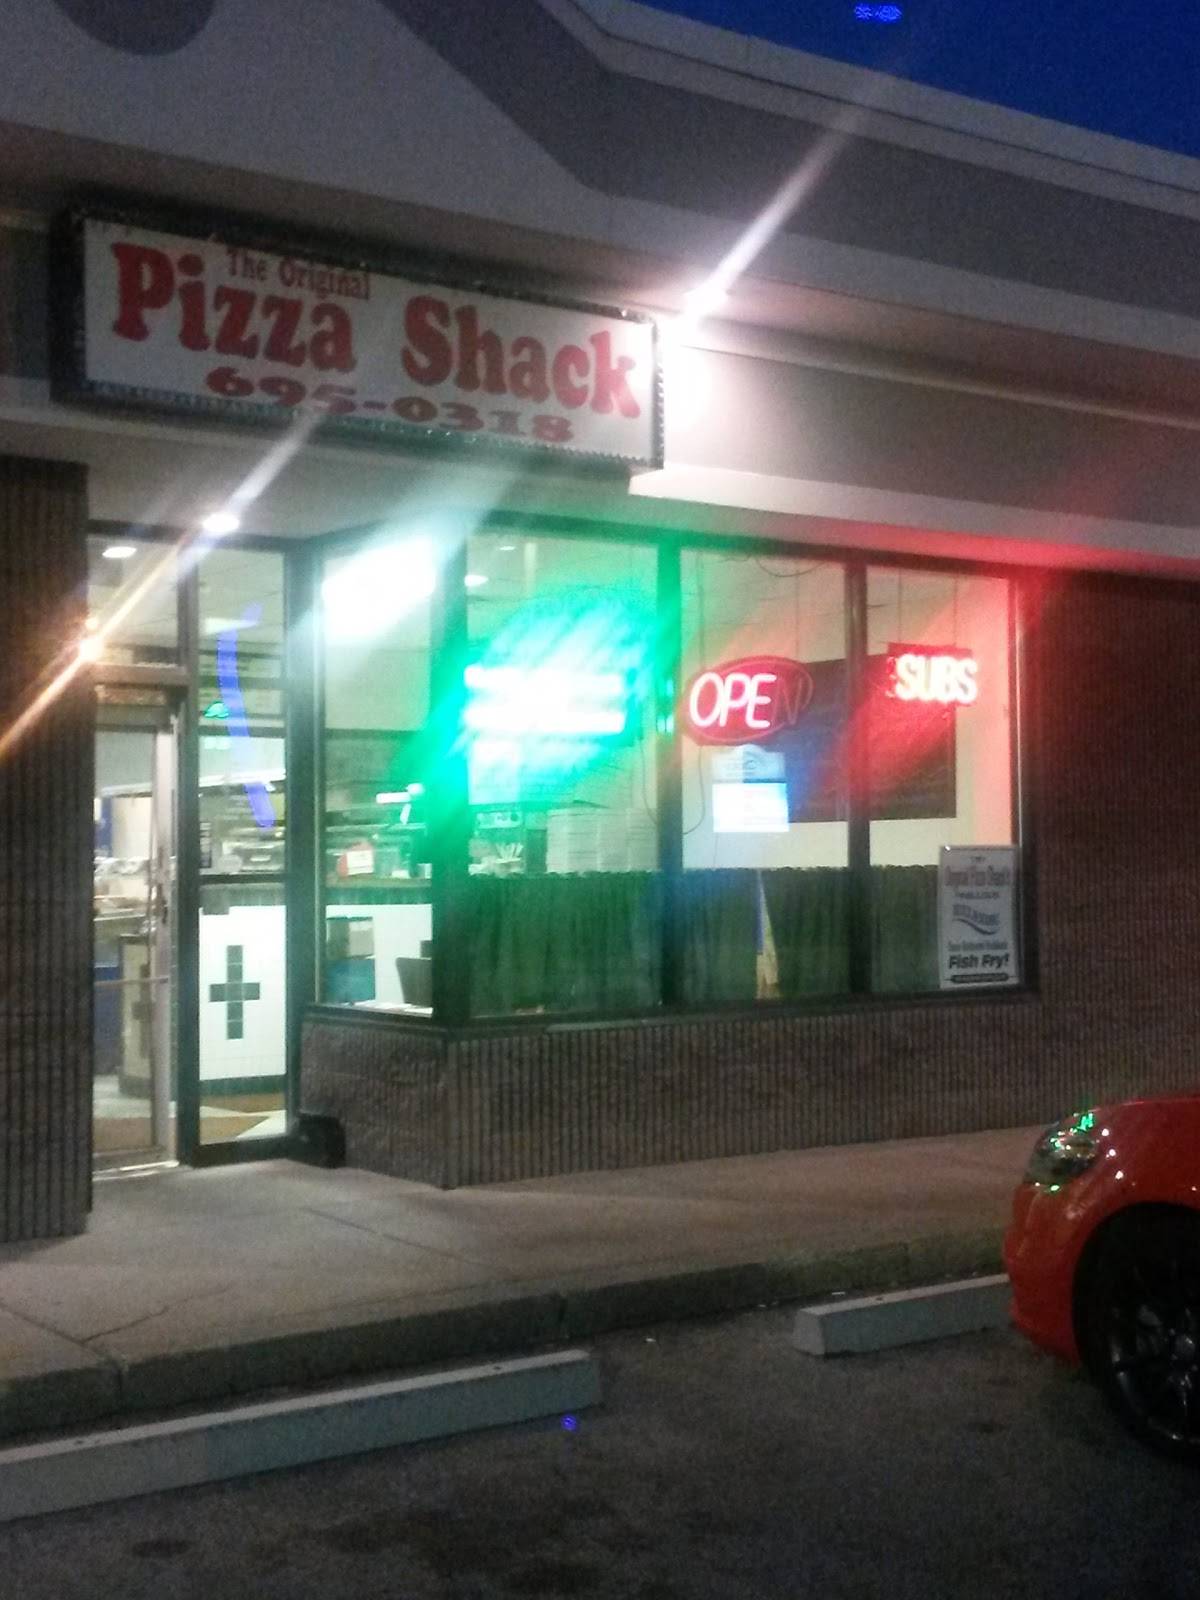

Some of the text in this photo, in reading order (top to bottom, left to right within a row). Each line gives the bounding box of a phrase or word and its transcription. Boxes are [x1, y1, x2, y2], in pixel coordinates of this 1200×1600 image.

[226, 249, 370, 300] The Original
[111, 241, 641, 419] Pizza Shack
[206, 366, 574, 443] 695-0318
[894, 653, 978, 704] SUBS
[949, 953, 1010, 970] Fish Fry!
